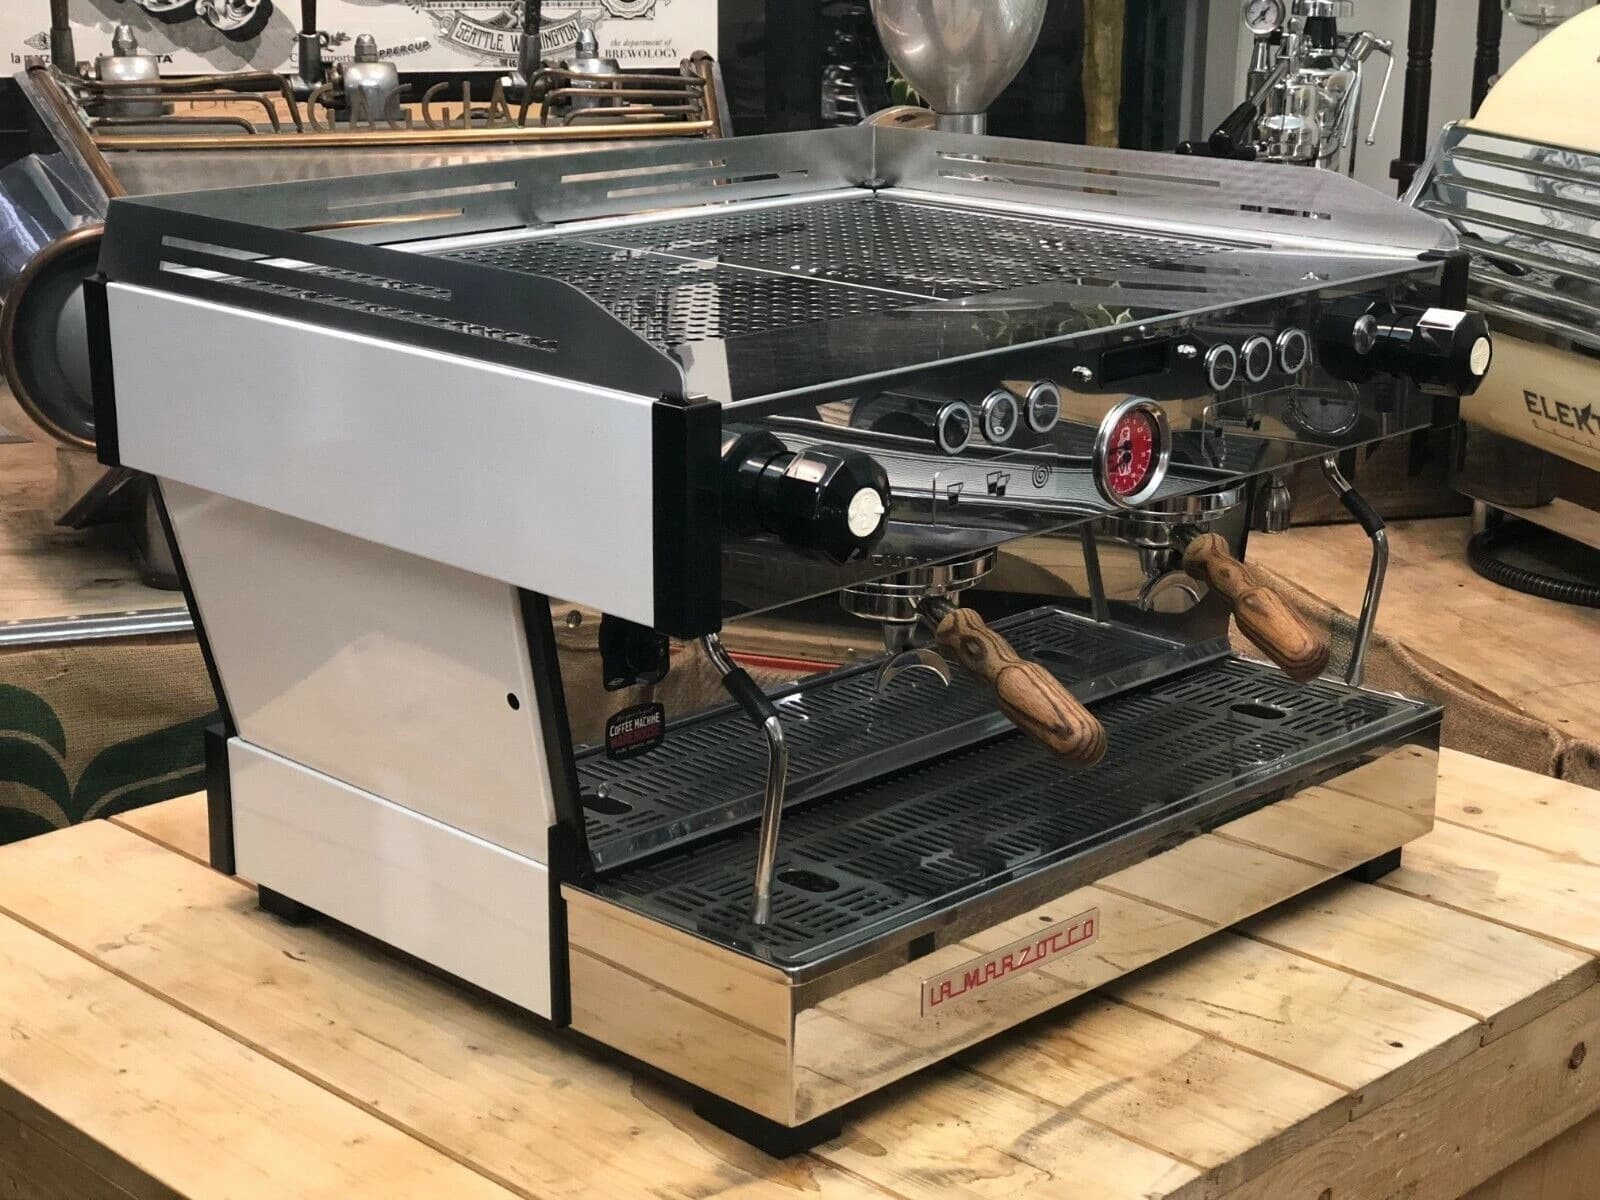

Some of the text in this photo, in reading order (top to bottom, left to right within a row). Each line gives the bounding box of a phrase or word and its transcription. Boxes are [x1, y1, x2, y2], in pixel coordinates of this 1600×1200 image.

[510, 22, 580, 52] WINGTON
[378, 40, 432, 58] PPERCUP
[605, 49, 678, 59] BREWOLOGY
[610, 720, 633, 737] COFFEE
[634, 712, 661, 730] MACHINE
